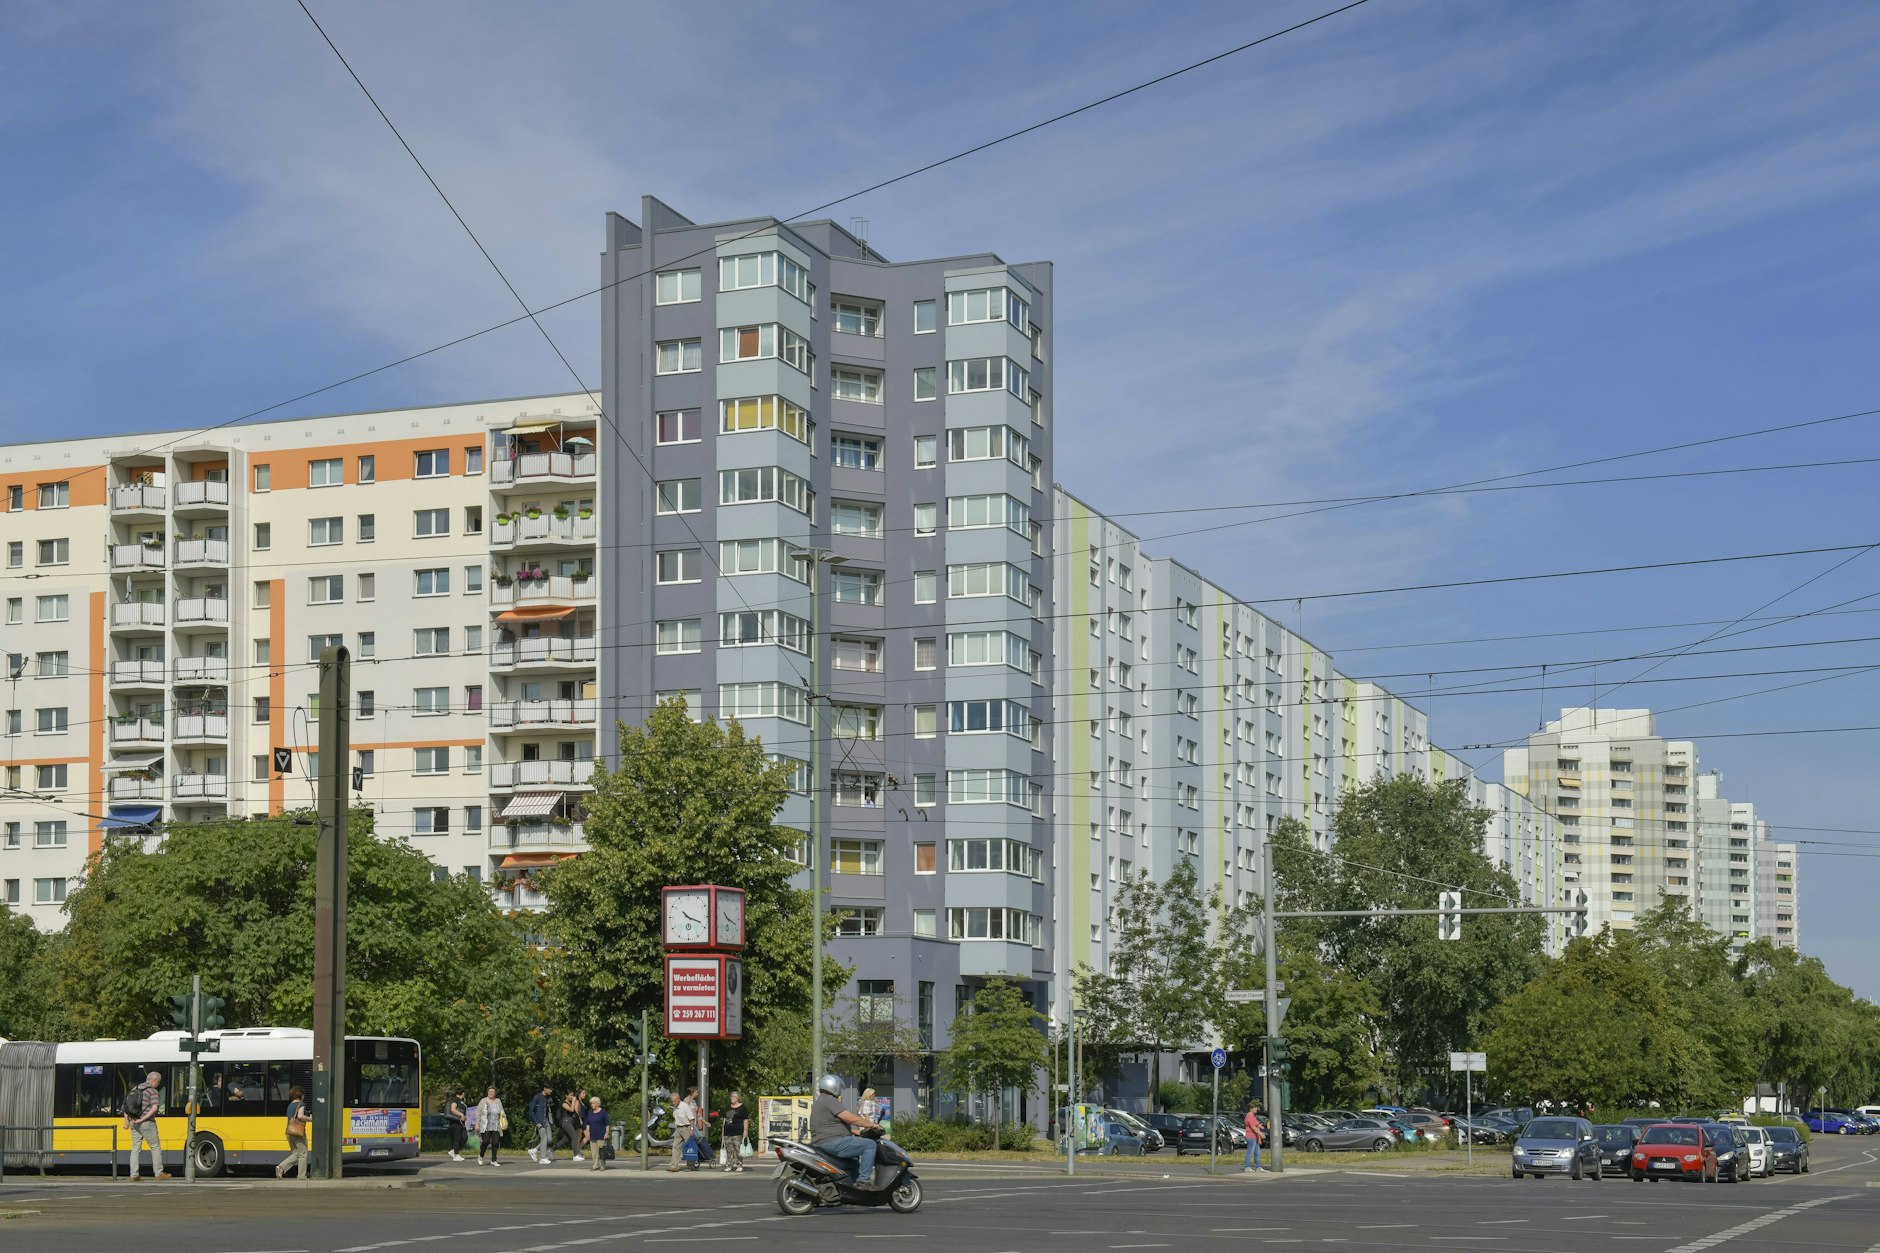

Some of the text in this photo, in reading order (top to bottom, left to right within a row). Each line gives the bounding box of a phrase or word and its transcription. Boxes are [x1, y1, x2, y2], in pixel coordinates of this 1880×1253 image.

[682, 1010, 715, 1018] 259 267 111
